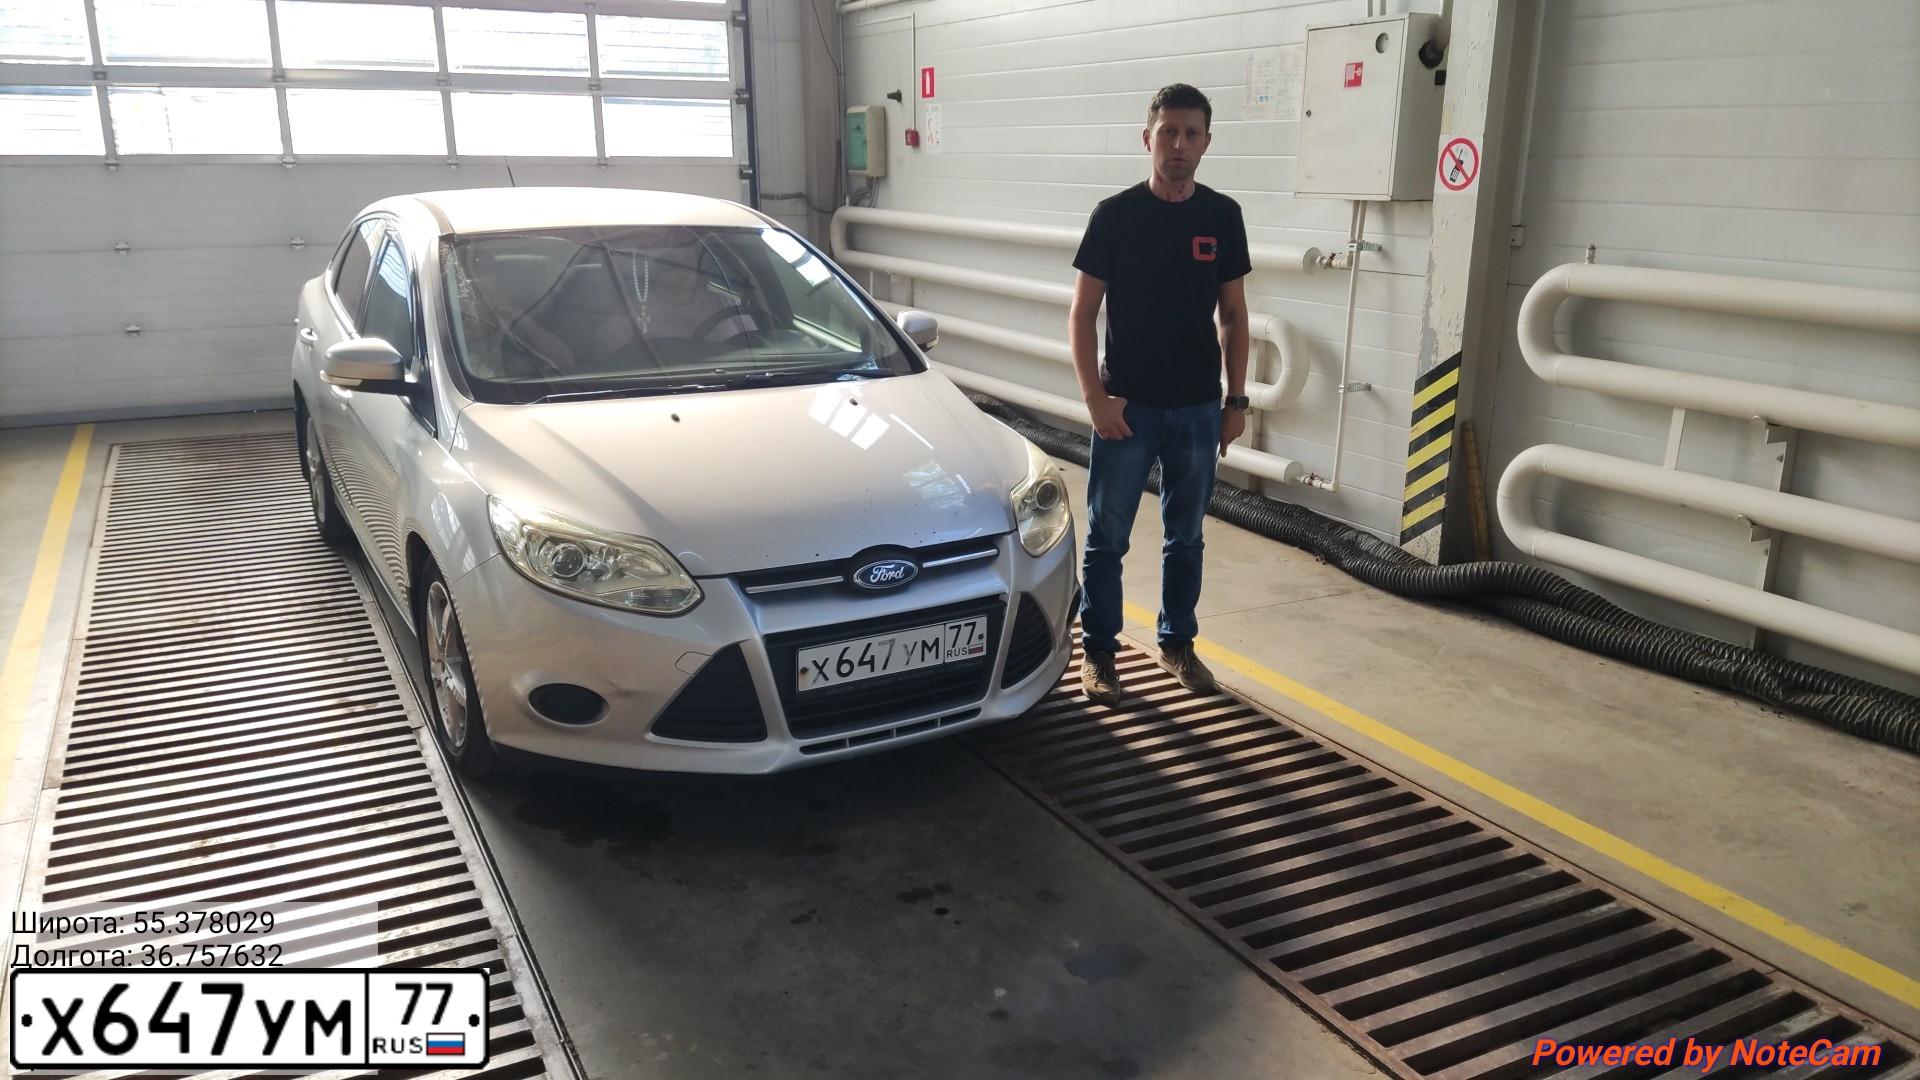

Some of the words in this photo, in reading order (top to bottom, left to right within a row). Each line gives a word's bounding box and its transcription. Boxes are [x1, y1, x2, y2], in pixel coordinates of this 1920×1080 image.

[869, 564, 905, 583] Ford
[948, 621, 977, 647] 77
[946, 646, 969, 658] RUS
